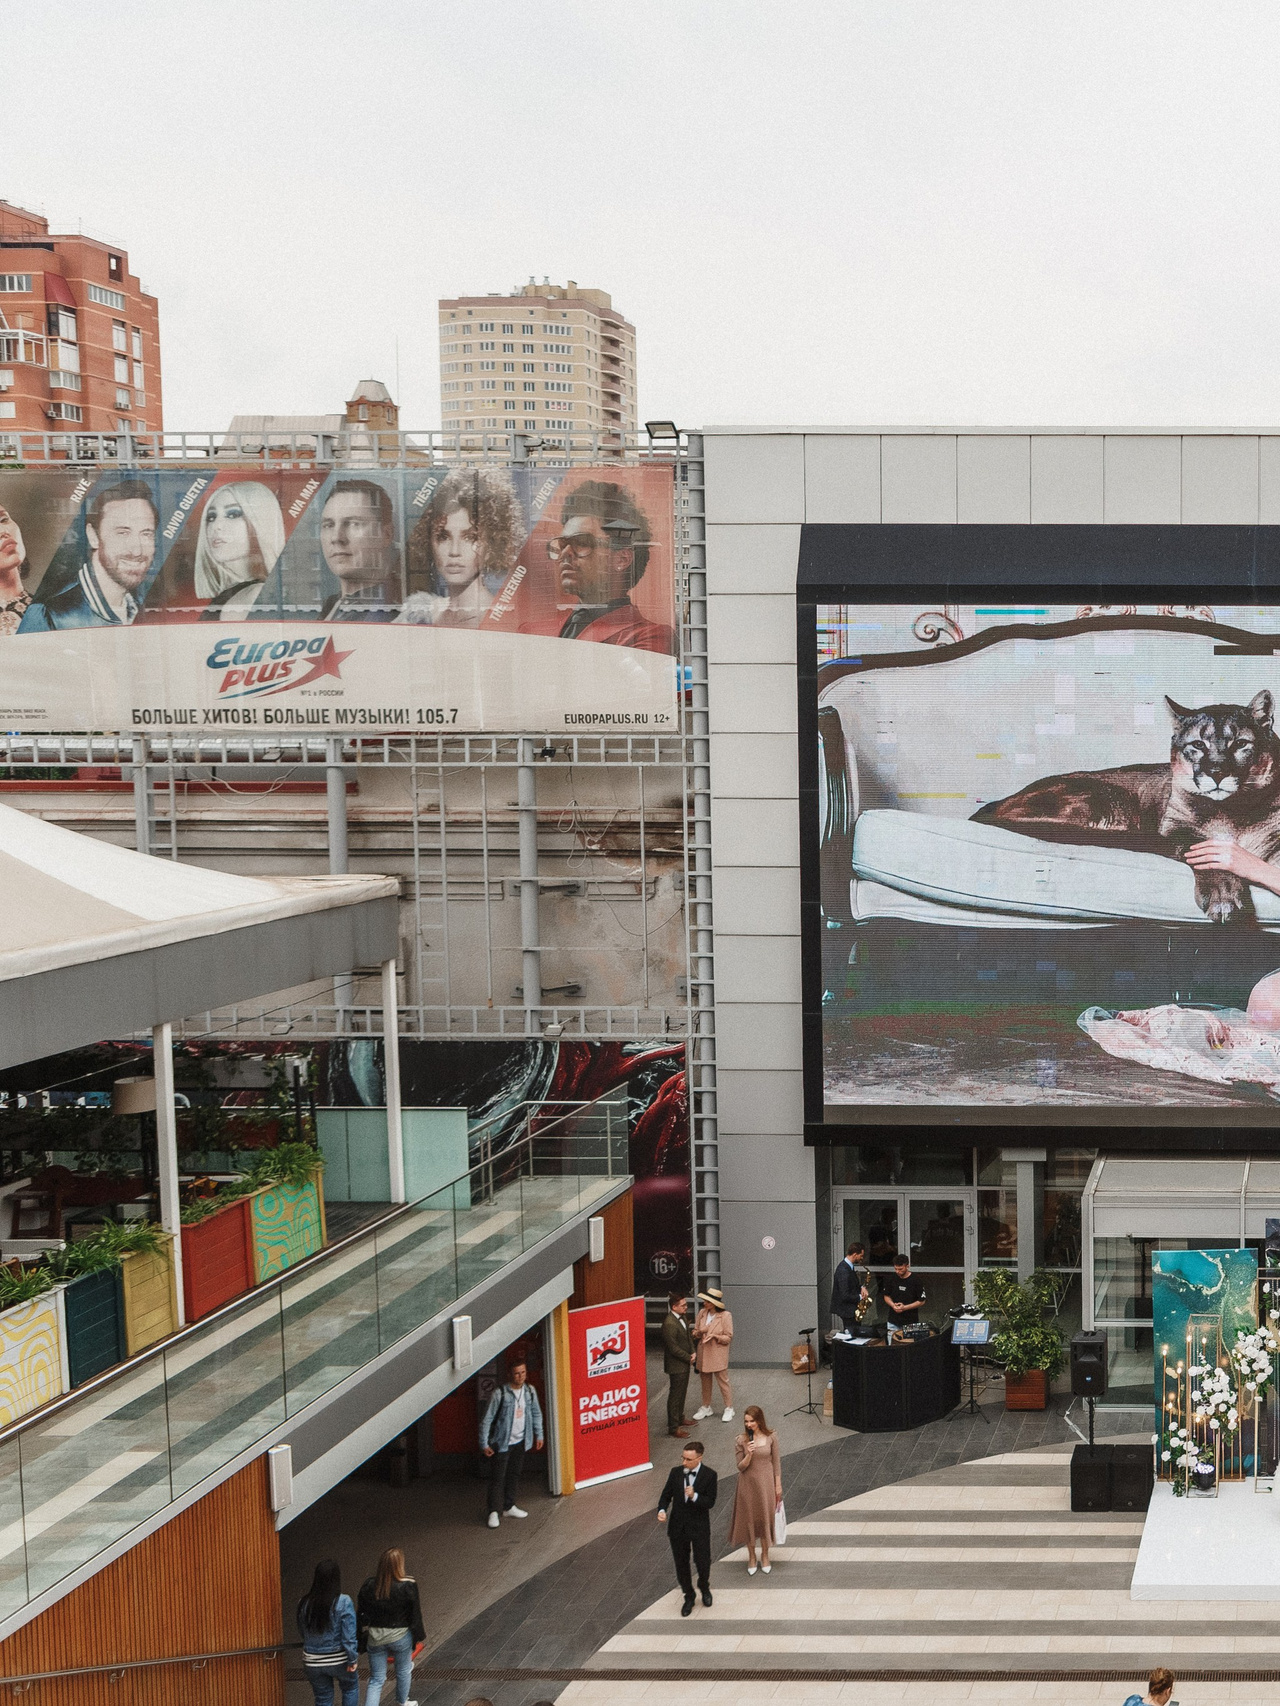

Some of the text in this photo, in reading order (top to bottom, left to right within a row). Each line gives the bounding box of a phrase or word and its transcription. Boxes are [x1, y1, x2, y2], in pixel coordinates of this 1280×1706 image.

[70, 478, 91, 503] RAYE
[288, 478, 320, 518] AVA MAX
[412, 477, 438, 508] TIËSTO
[531, 477, 557, 510] ZIVERT
[163, 477, 208, 539] DAVID GUETTA
[489, 564, 528, 622] THE WEEKND
[131, 708, 459, 725] БОЛЬШЕ ХИТОВ! БОЛЬШЕ МУЗЫКИ! 105.7
[564, 713, 670, 724] EUROPAPLUS.RU 12+
[652, 1257, 676, 1274] 16+
[589, 1366, 612, 1377] ENERGY
[579, 1384, 641, 1411] РАДИО
[579, 1399, 641, 1426] ENERGY
[580, 1420, 615, 1435] СЛУШАЙ
